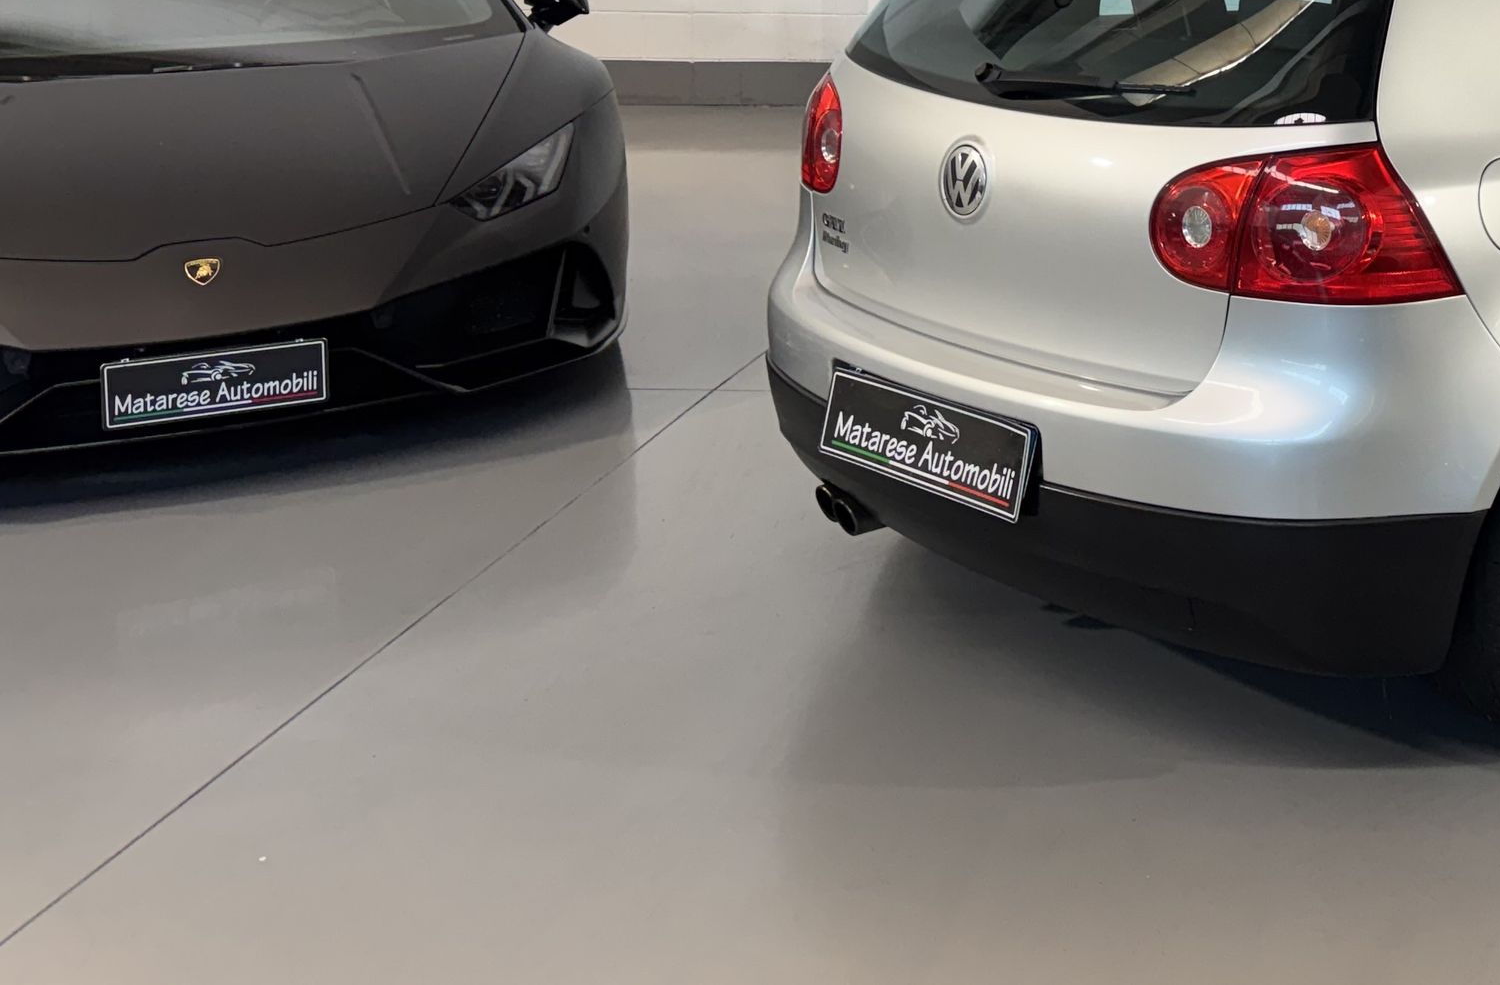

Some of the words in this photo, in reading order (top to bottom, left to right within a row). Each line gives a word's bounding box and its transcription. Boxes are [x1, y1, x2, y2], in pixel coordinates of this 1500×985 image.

[943, 145, 987, 215] VW
[114, 389, 211, 416] Matarese
[216, 370, 318, 402] Automobili
[834, 411, 917, 464] Matarese
[918, 441, 1016, 499] Automobili
